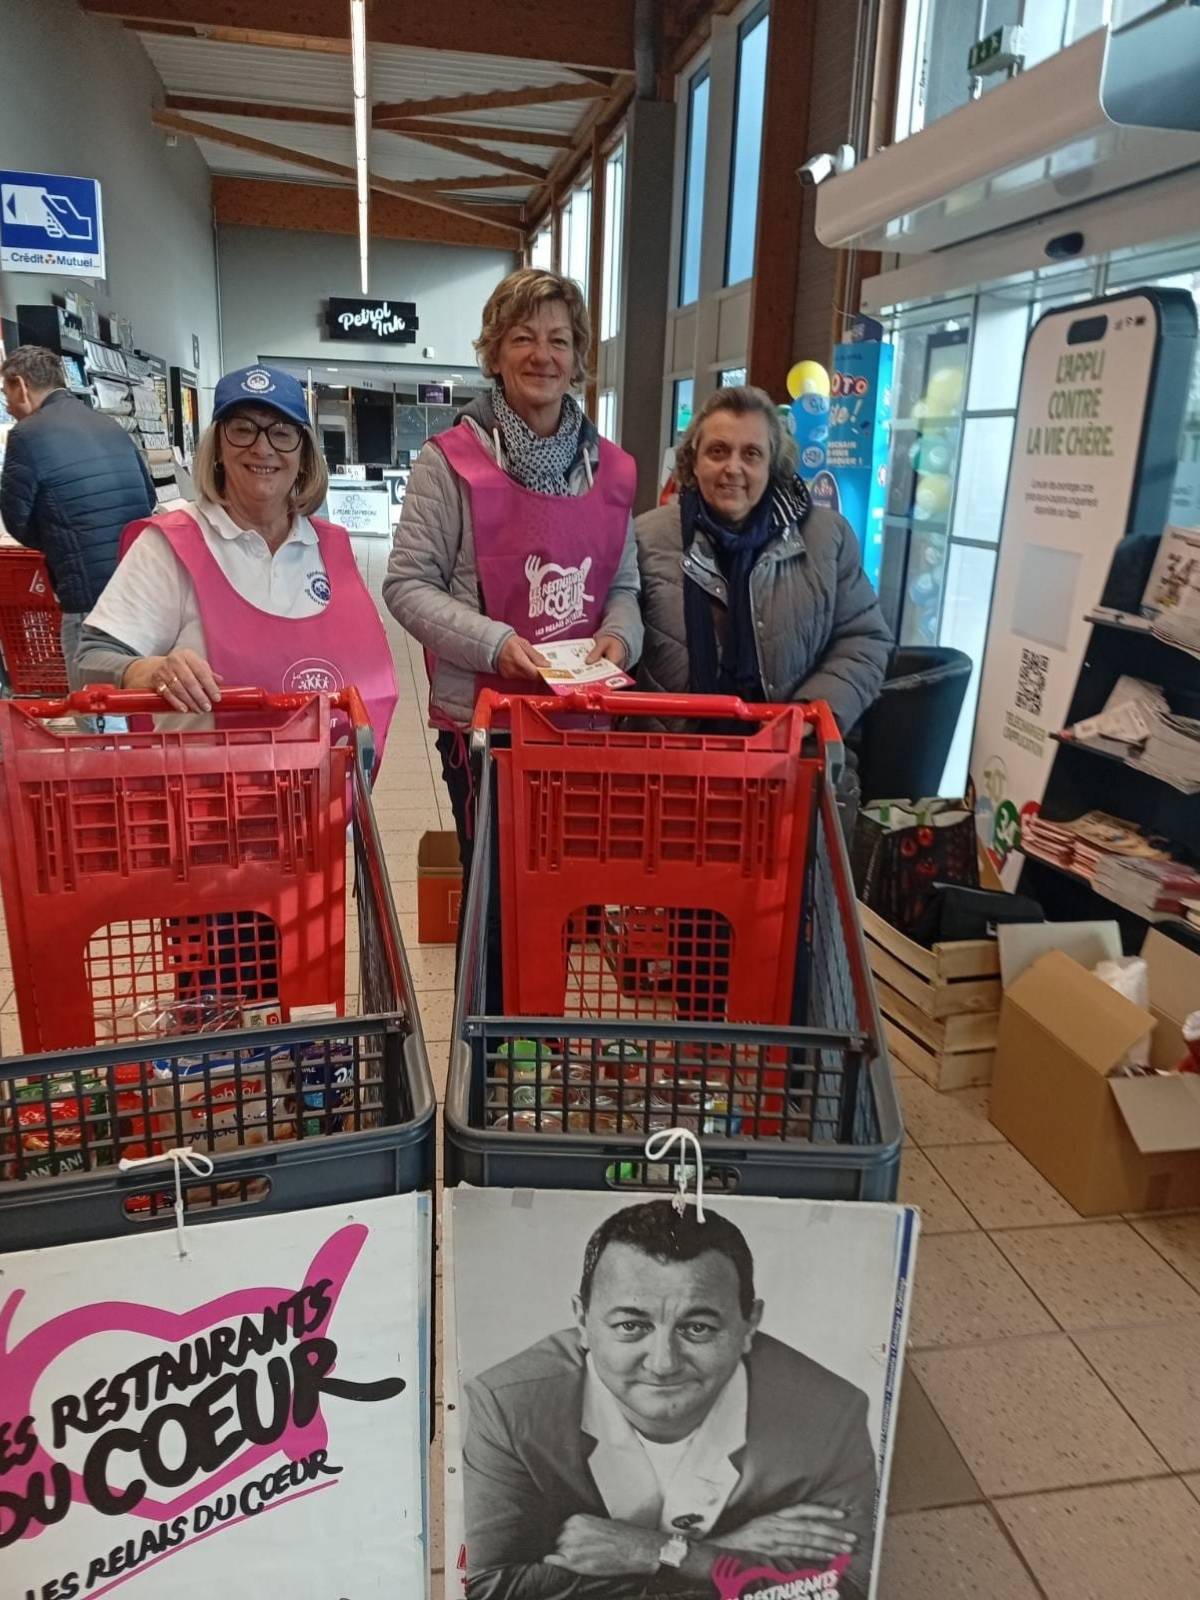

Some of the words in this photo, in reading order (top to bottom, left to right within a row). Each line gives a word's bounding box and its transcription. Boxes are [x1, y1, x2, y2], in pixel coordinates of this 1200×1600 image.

[11, 252, 44, 264] Crédit
[56, 255, 93, 267] Mutuel
[338, 301, 391, 331] Petrol
[371, 315, 406, 336] Ink
[1056, 349, 1106, 384] L'APPLI
[831, 371, 868, 396] OTO
[1048, 388, 1102, 420] CONTRE
[1026, 427, 1042, 455] LA
[1043, 427, 1065, 455] VIE
[0, 1415, 39, 1475] ES
[52, 1279, 333, 1449] RESTAURANTS
[0, 1463, 71, 1549] DU
[85, 1517, 187, 1589] RELAIS
[193, 1494, 234, 1534] DU
